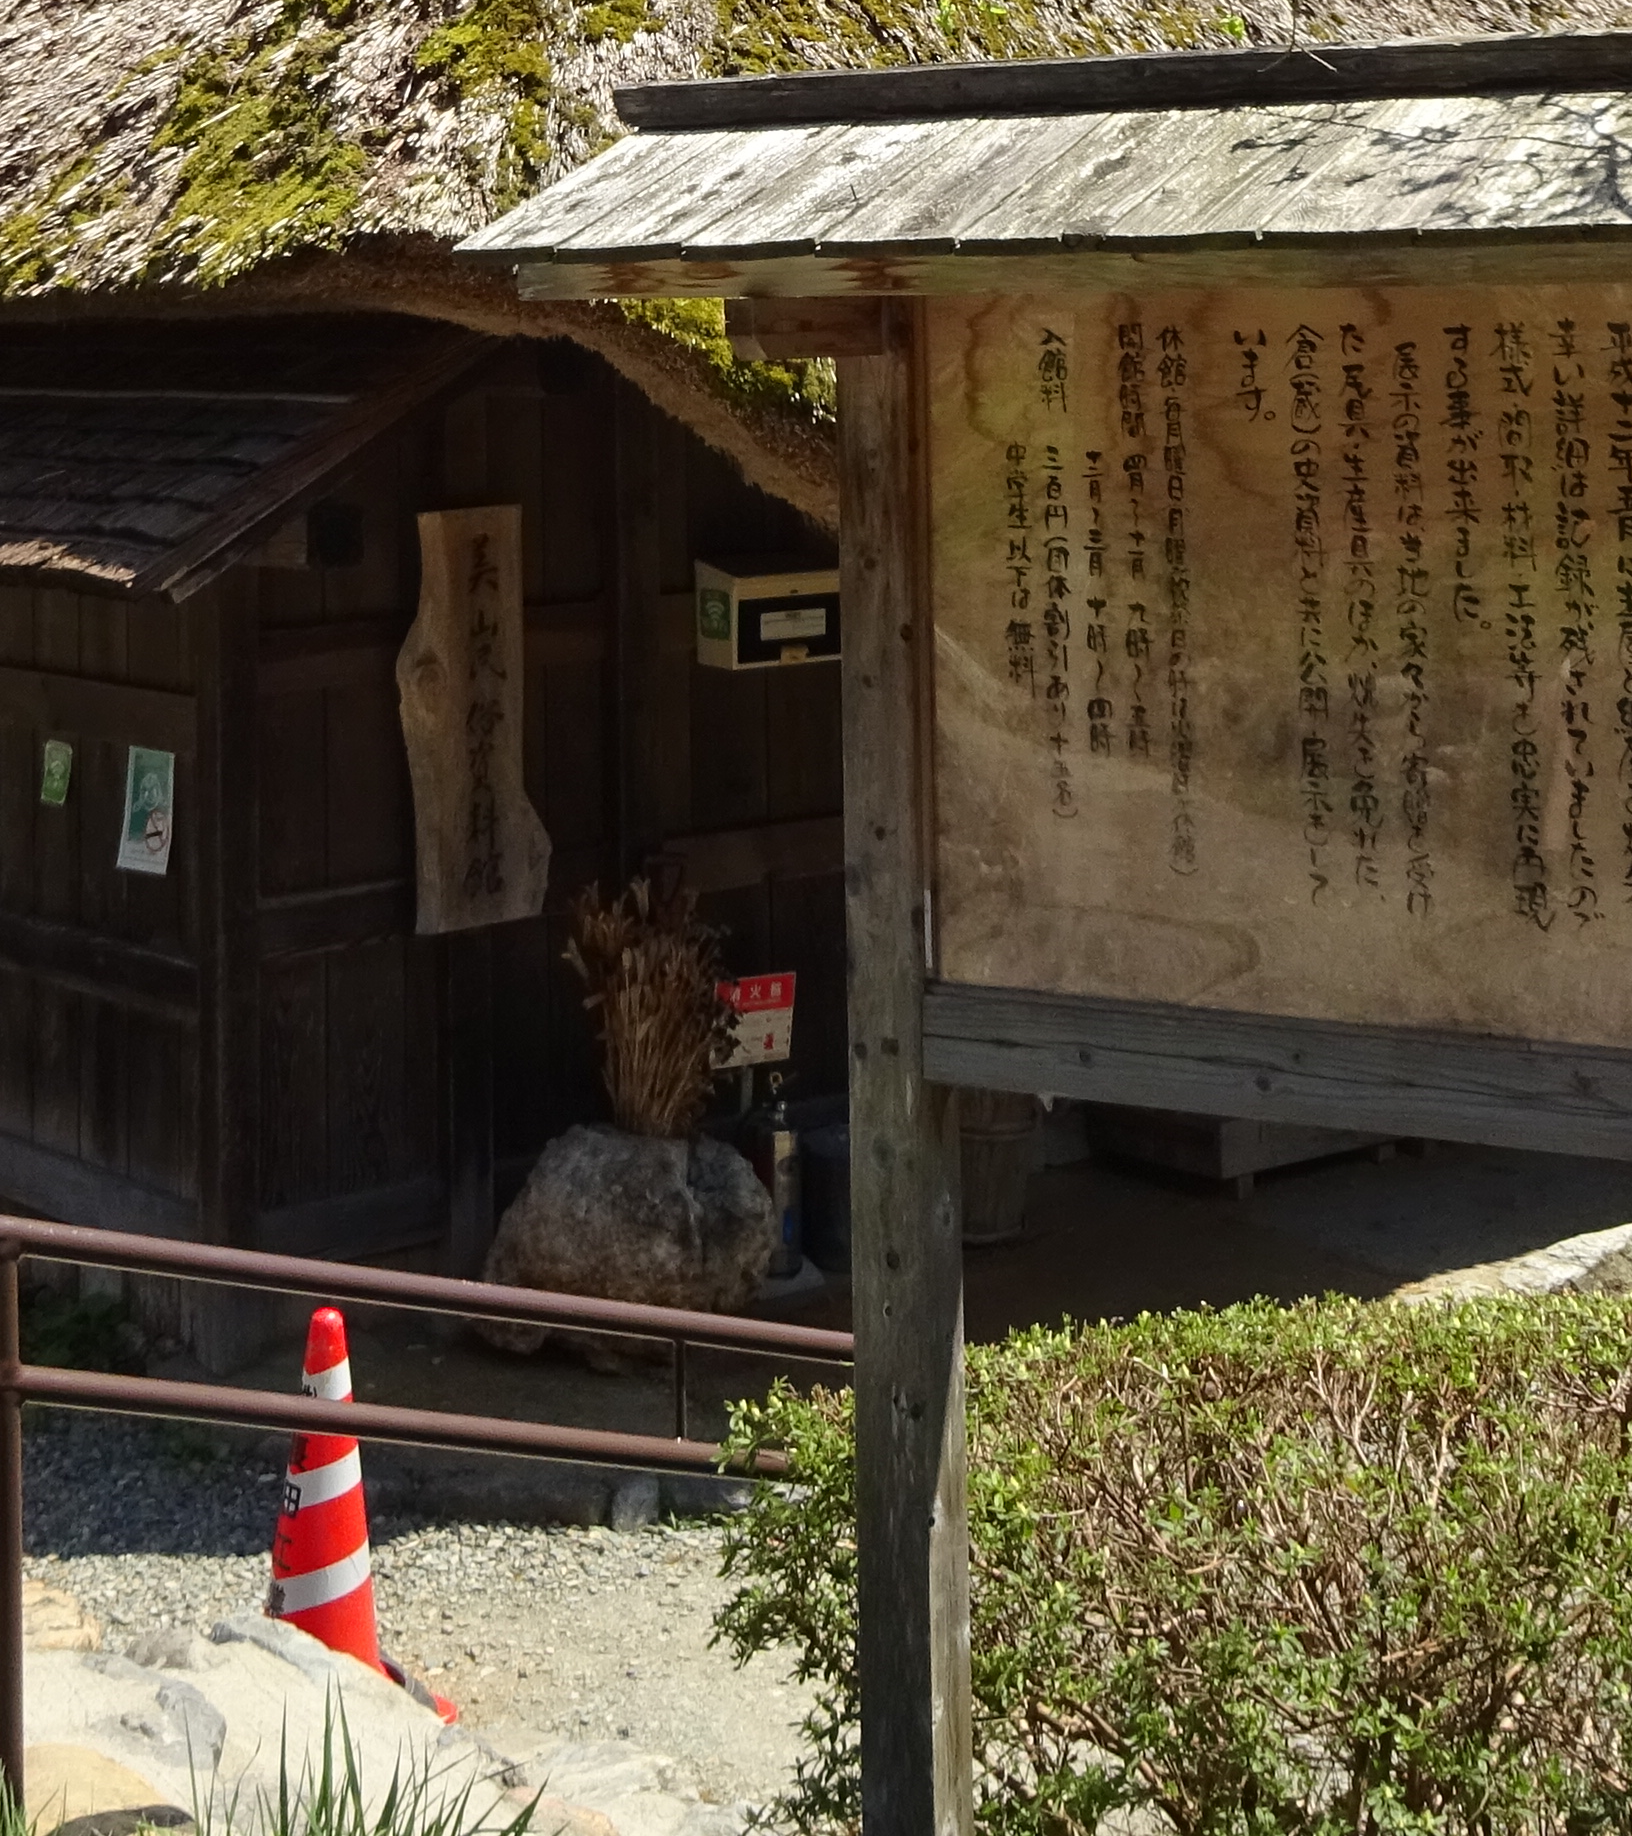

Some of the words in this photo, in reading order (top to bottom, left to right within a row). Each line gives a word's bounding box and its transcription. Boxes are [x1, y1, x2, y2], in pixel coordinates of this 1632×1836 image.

[1038, 327, 1067, 414] 入館料
[1233, 328, 1276, 422] います。
[464, 532, 507, 898] 美山民俗資料館
